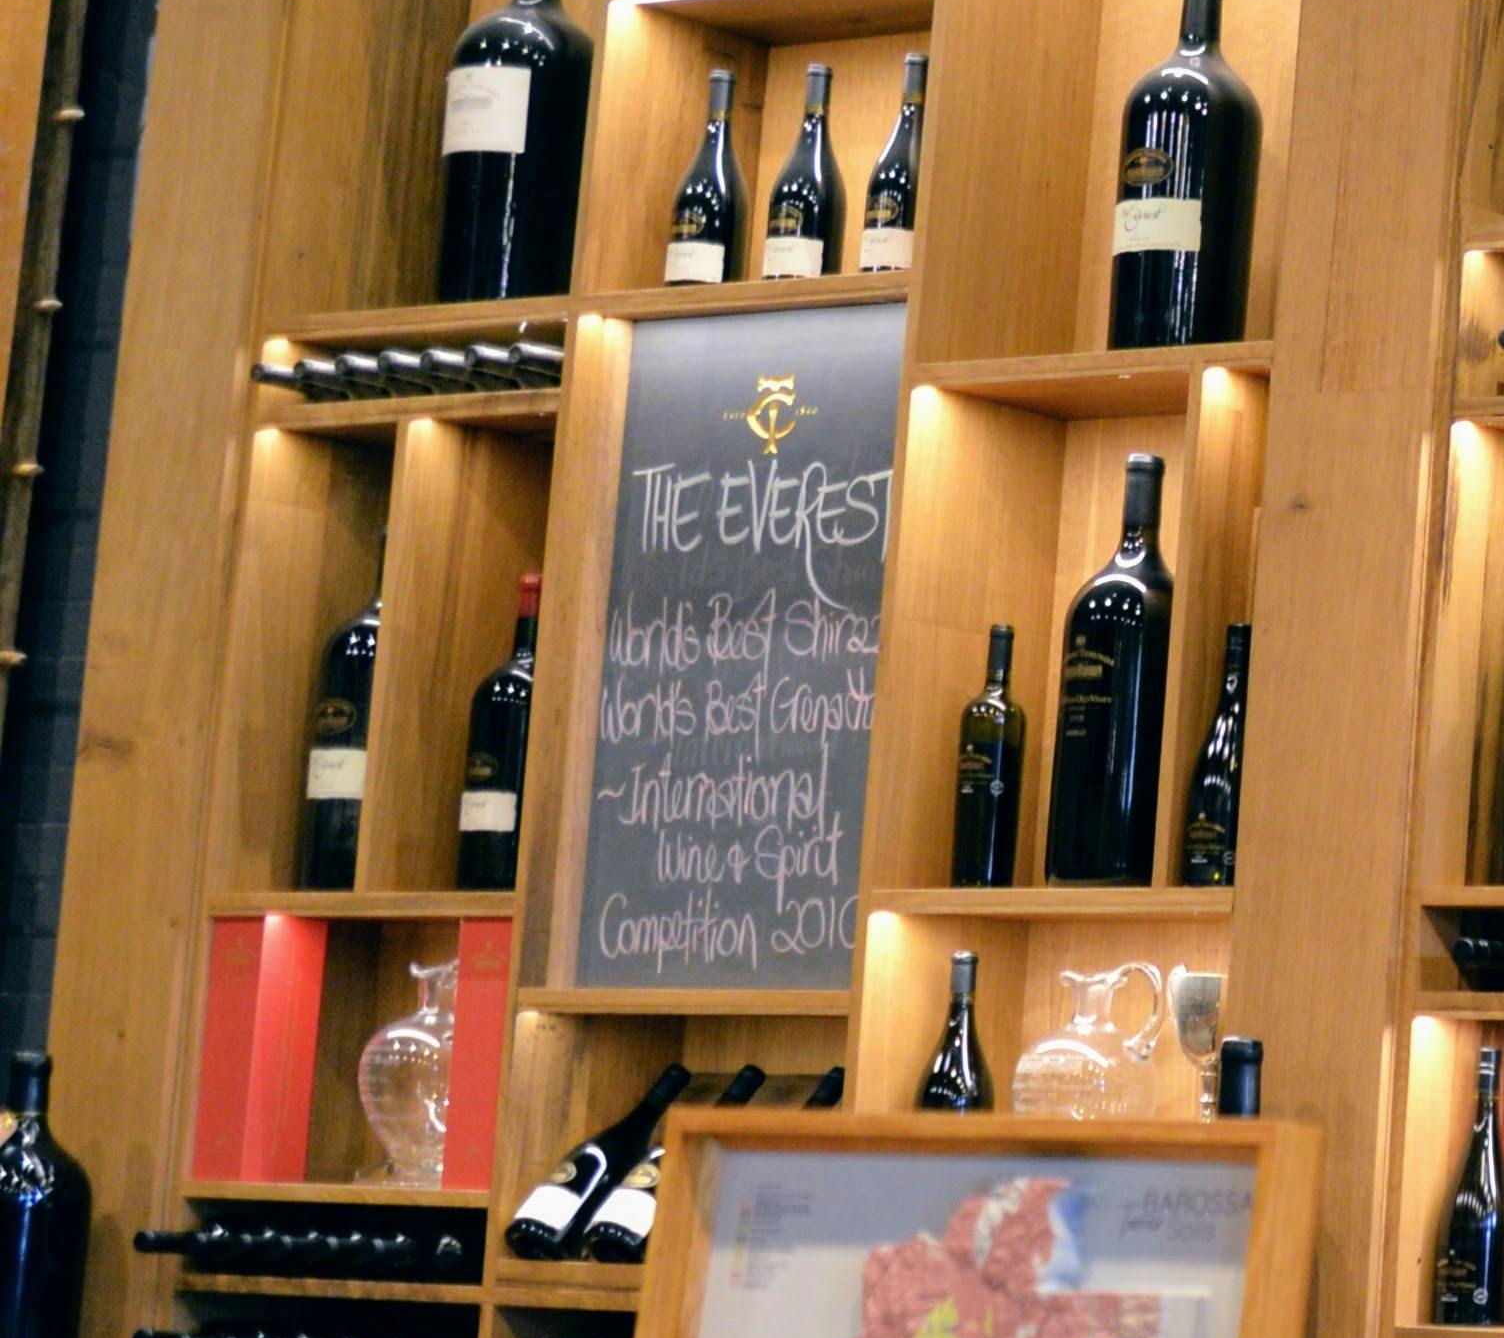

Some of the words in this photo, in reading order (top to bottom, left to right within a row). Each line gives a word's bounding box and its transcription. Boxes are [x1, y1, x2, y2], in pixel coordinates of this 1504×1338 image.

[632, 462, 712, 553] THE
[717, 458, 894, 610] EVEREST
[706, 587, 777, 693] Best
[705, 671, 767, 766] Best
[657, 829, 726, 884] Wine
[754, 810, 844, 915] Spirit
[599, 888, 758, 974] Competition
